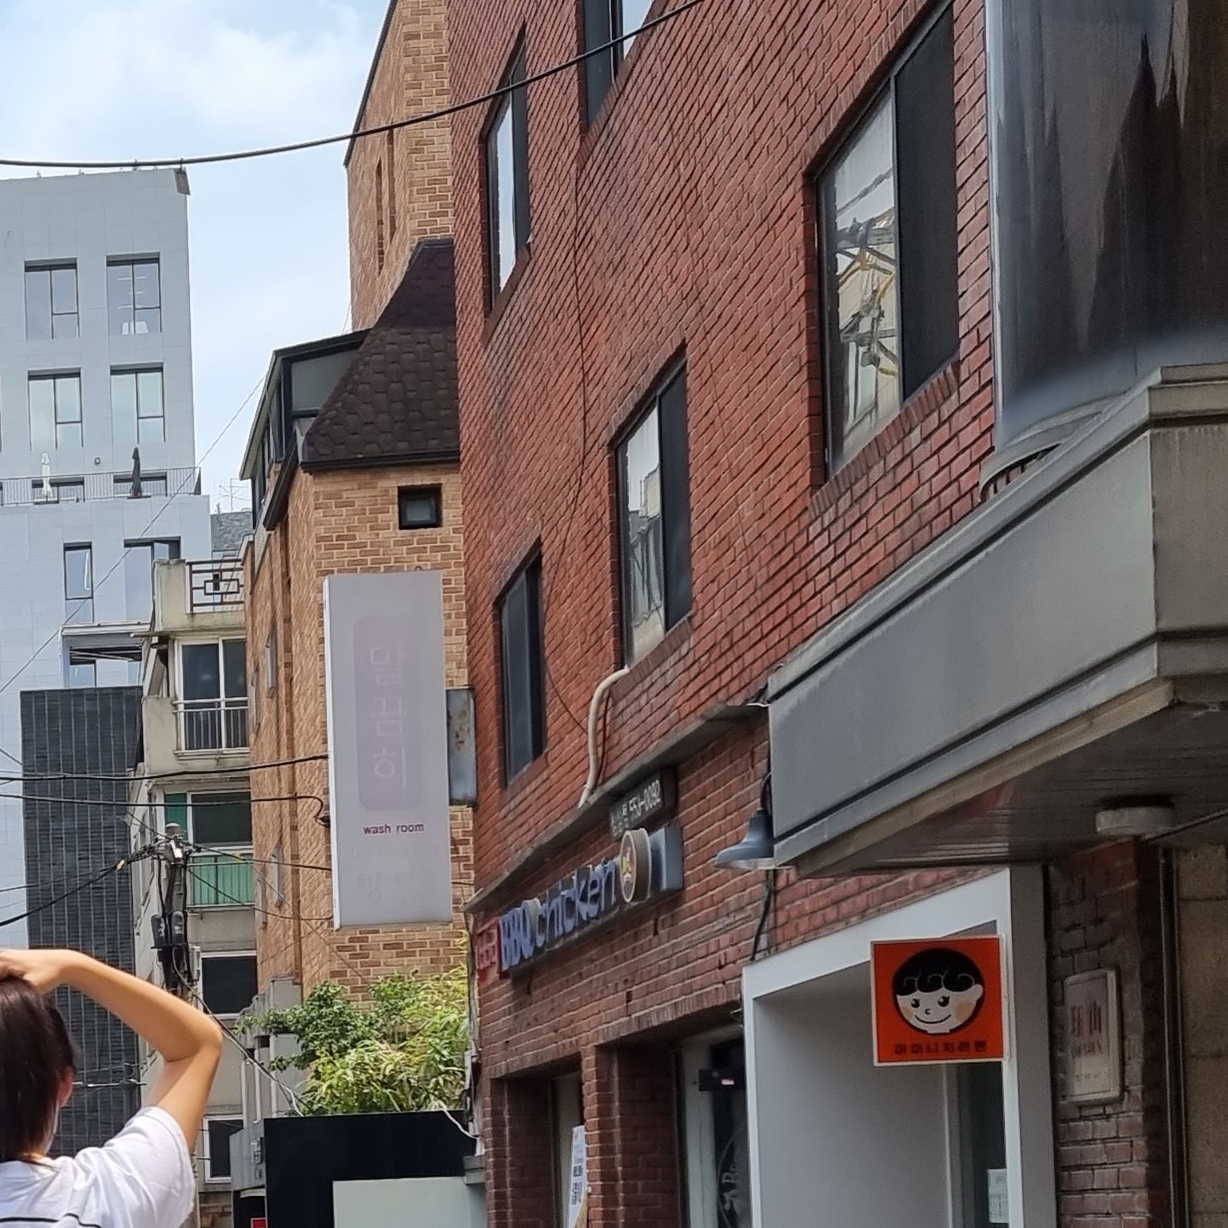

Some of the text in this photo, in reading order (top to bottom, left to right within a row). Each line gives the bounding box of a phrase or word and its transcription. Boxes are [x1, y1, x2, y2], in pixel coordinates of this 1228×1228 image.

[363, 823, 425, 835] wash room
[499, 898, 538, 972] BBQ
[536, 858, 617, 948] chicken
